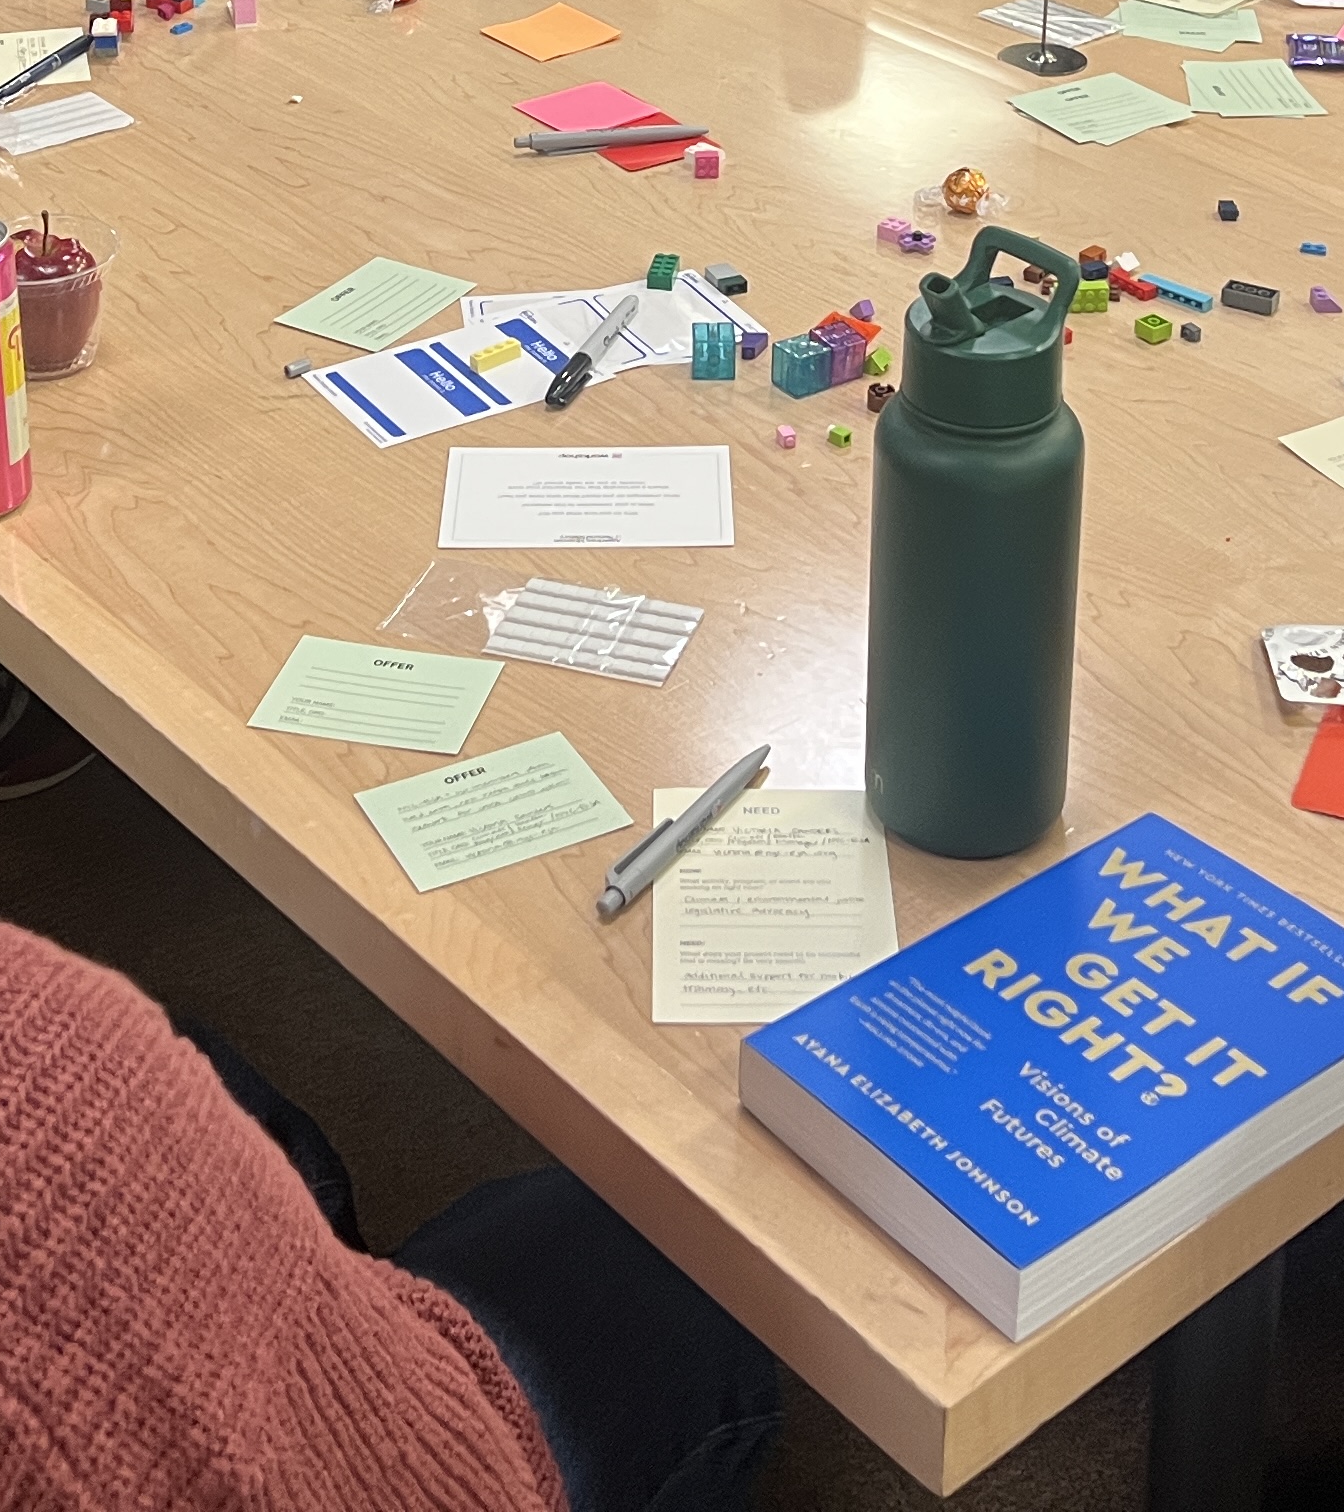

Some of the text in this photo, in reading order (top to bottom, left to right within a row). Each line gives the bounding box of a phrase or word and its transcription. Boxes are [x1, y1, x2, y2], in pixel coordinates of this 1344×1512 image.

[428, 369, 456, 392] Hello
[530, 339, 558, 362] Hello
[373, 658, 415, 672] OFFER
[443, 766, 487, 786] OFFER
[742, 805, 781, 816] NEED
[1098, 846, 1279, 962] WHAT
[1165, 849, 1196, 869] NEW
[1198, 868, 1234, 893] YORK
[1236, 891, 1277, 919] TIMES
[1087, 897, 1192, 974] WE
[961, 947, 1189, 1107] RIGHT?
[1064, 952, 1198, 1036] GET
[1184, 1036, 1269, 1088] IT
[791, 1033, 1042, 1228] AYANA ELIZABETH JOHNSON
[978, 1097, 1066, 1169] Futures
[1018, 1060, 1132, 1149] Visions of
[1034, 1107, 1124, 1182] Climate
